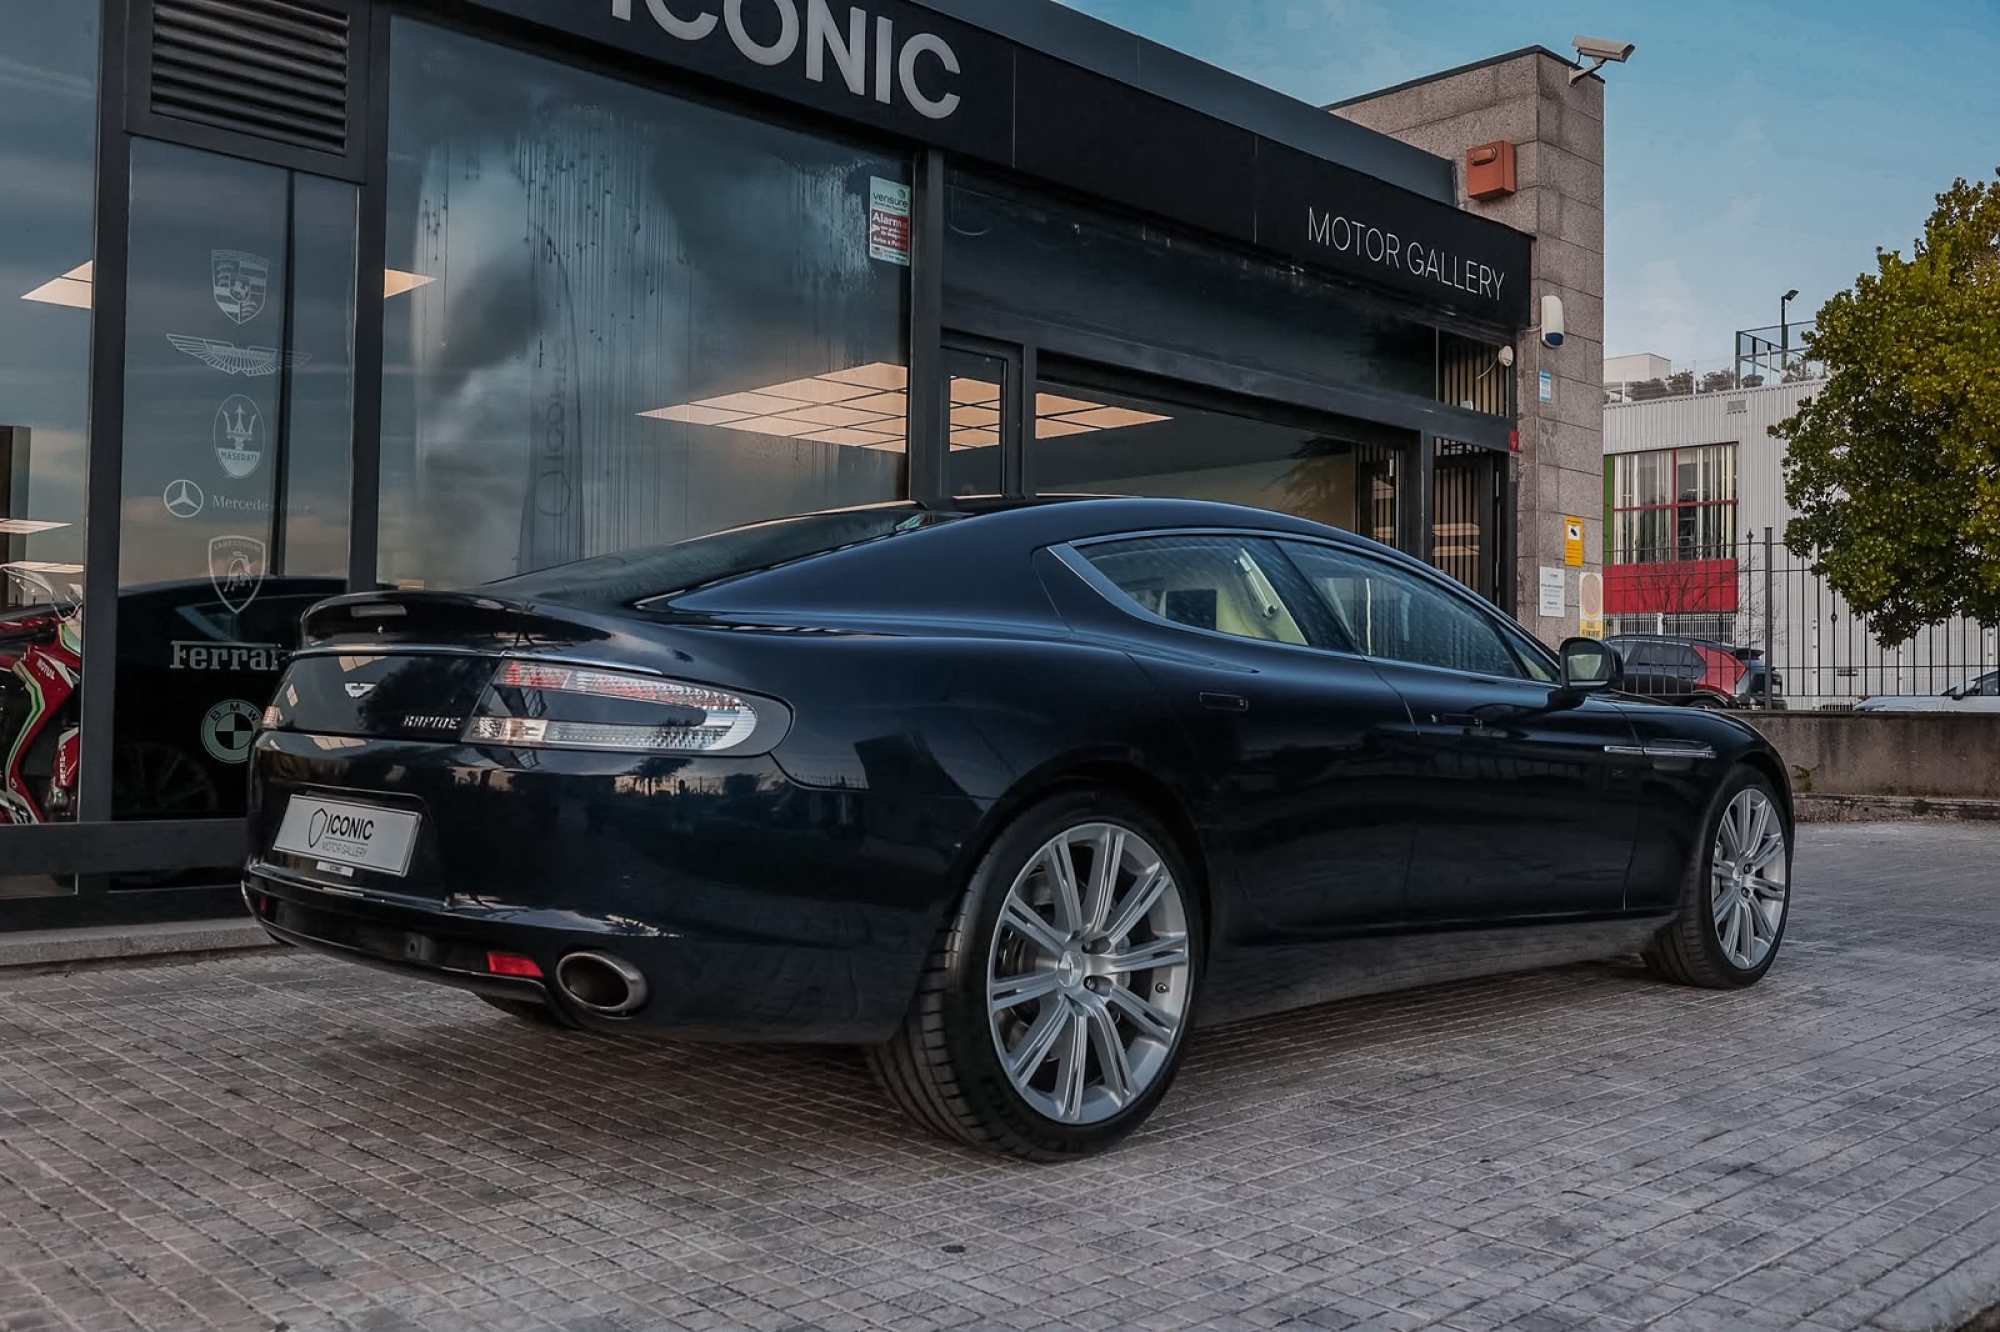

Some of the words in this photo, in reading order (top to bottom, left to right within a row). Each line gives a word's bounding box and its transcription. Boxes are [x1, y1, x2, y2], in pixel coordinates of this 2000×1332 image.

[611, 0, 961, 119] ONIC
[1308, 206, 1400, 269] MOTOR
[1407, 241, 1505, 300] GALLERY
[220, 452, 258, 462] MASERATI
[210, 703, 260, 722] BMW
[326, 814, 375, 840] ICONIC
